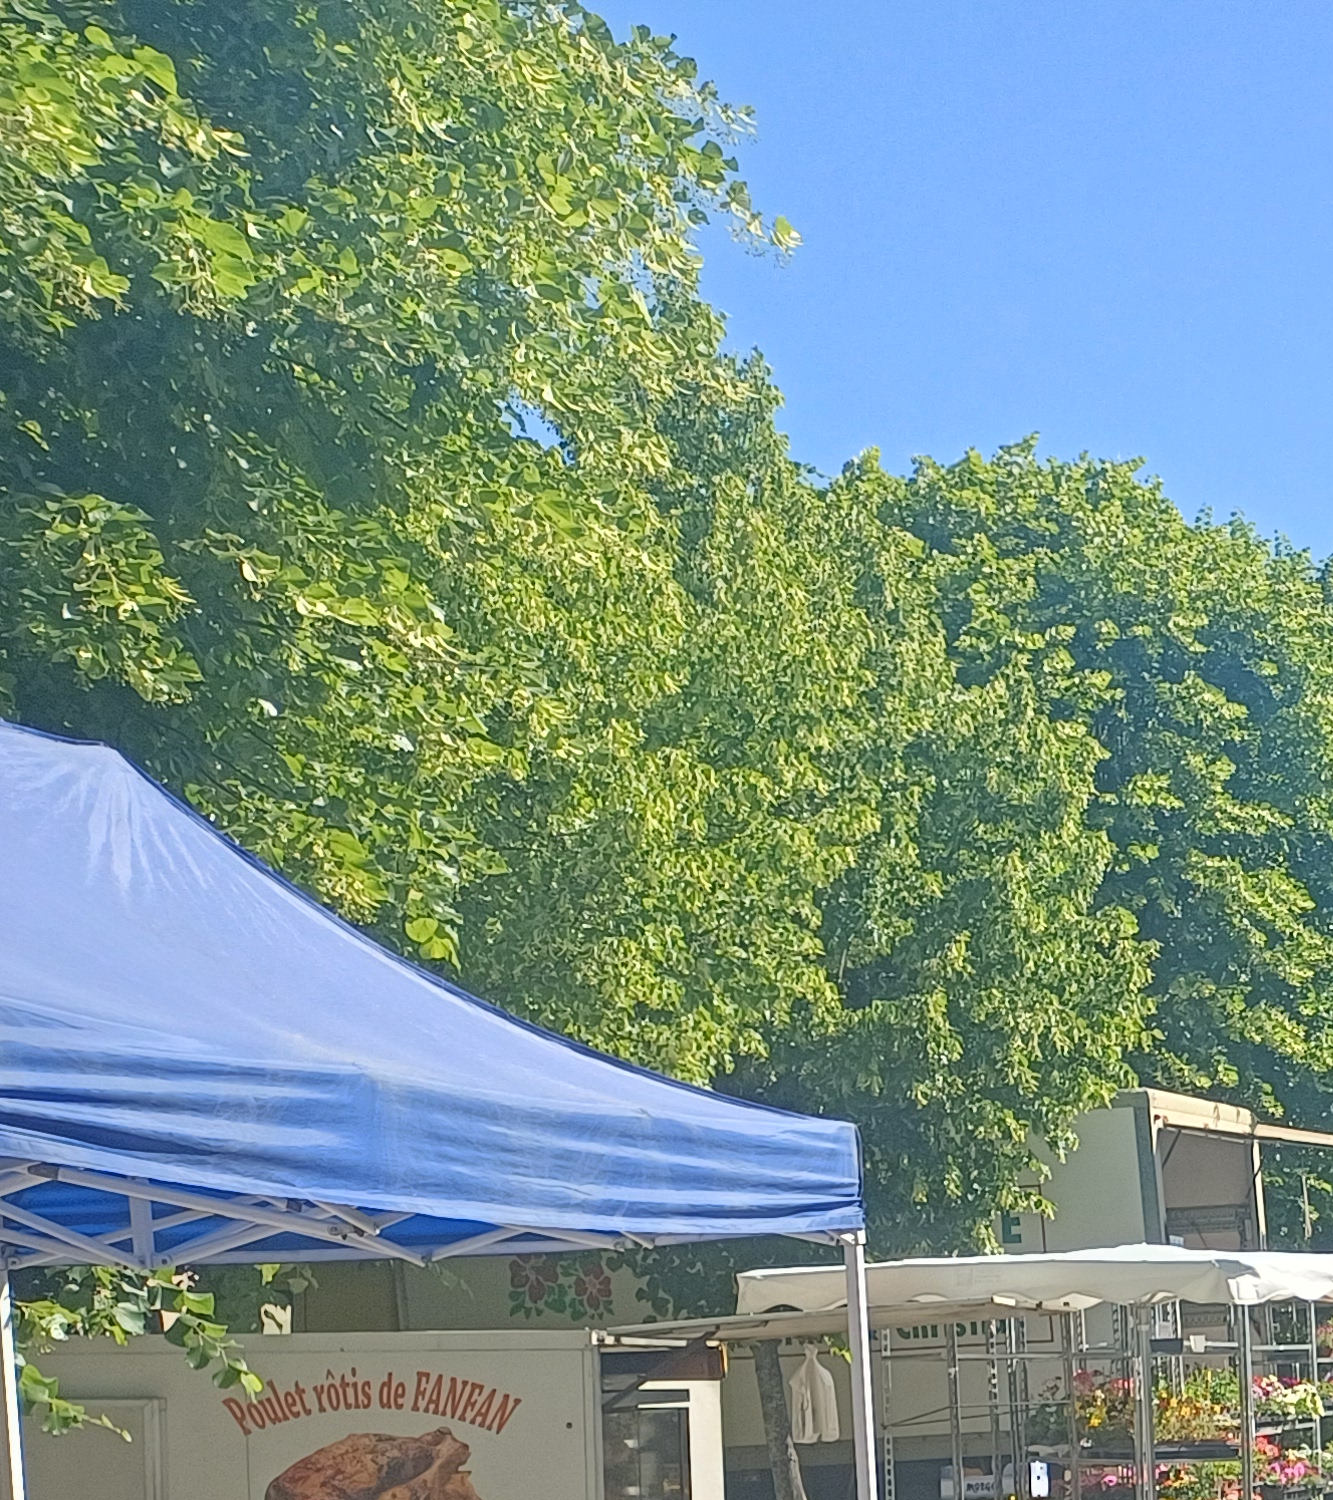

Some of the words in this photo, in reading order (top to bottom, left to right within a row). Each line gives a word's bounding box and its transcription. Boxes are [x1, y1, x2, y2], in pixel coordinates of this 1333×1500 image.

[222, 1380, 312, 1436] Poulet
[312, 1367, 372, 1413] rôtis
[379, 1372, 405, 1410] de
[411, 1371, 522, 1435] FANFAN
